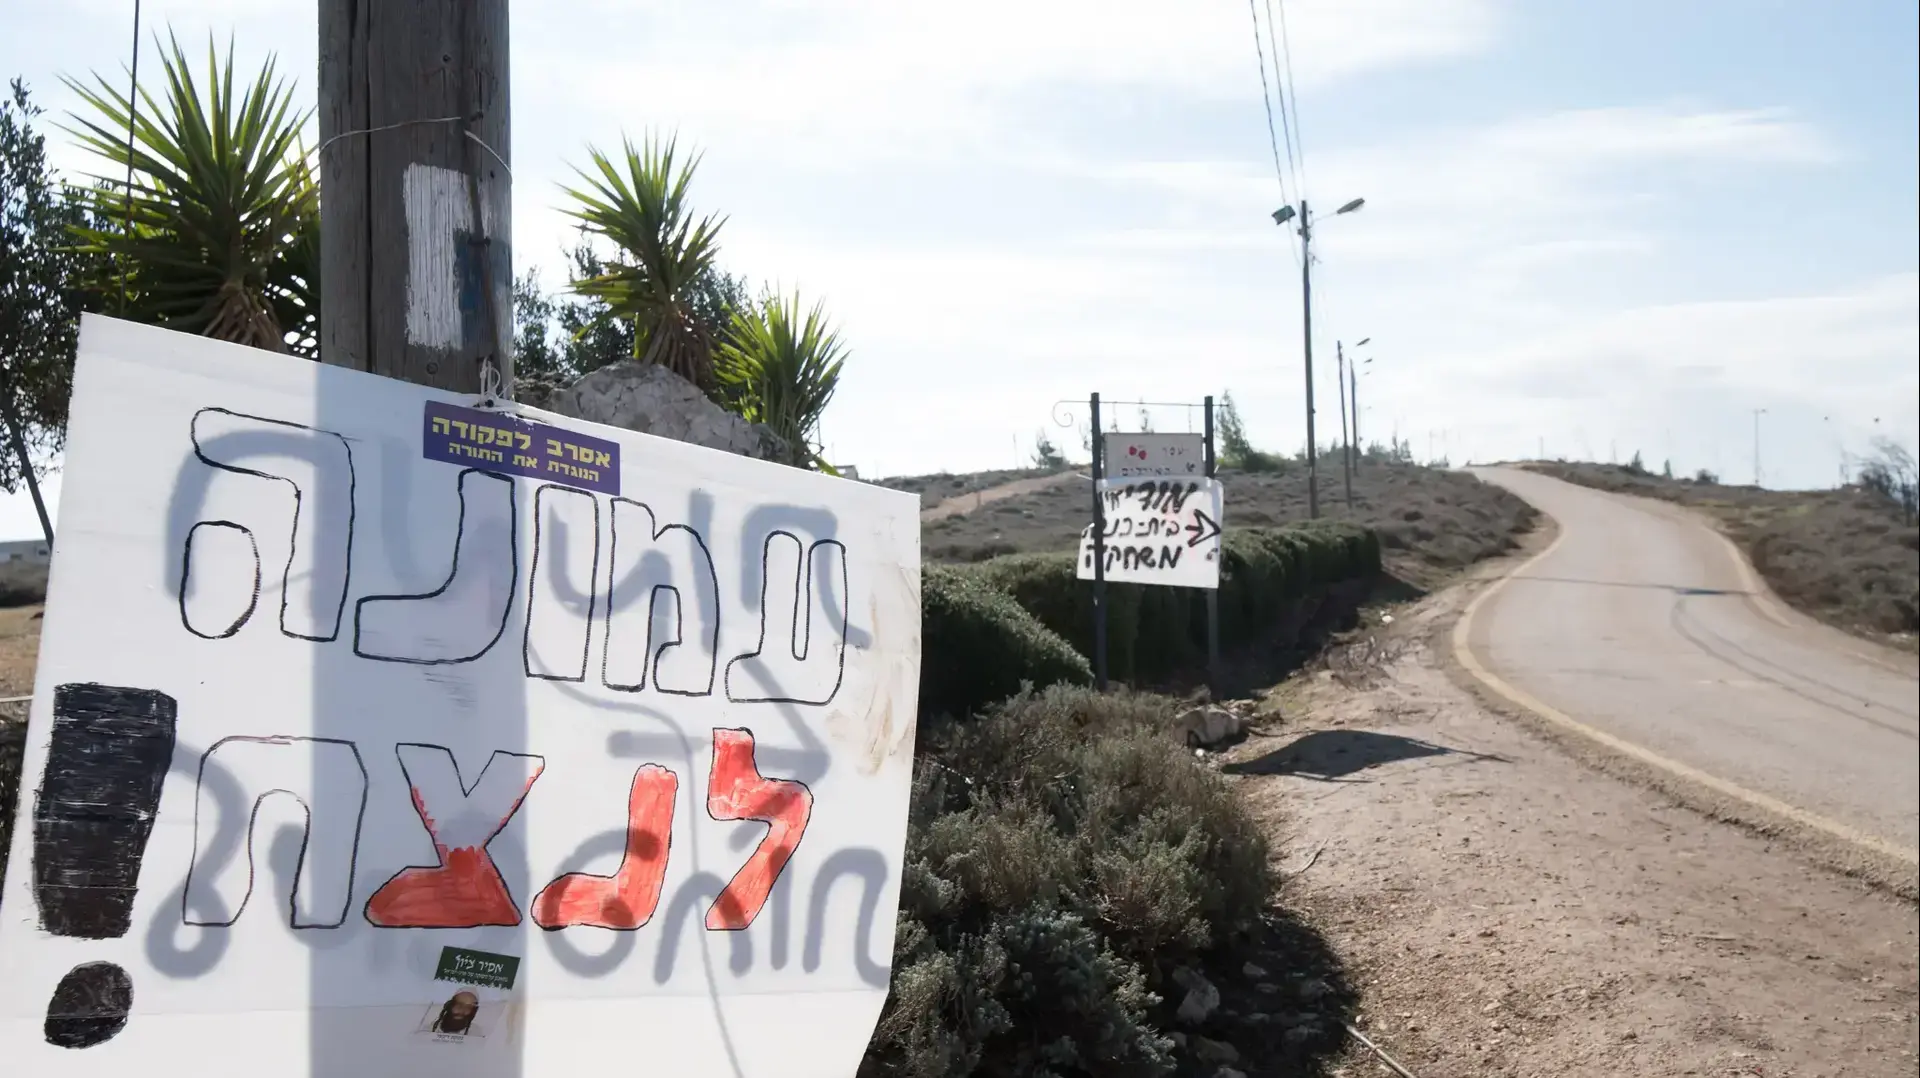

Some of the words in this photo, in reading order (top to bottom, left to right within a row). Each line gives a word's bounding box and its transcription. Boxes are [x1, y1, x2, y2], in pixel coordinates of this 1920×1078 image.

[432, 416, 532, 450] לפקודה
[448, 442, 504, 463] התורה
[512, 454, 538, 469] את
[546, 438, 611, 469] אסרב
[547, 460, 600, 483] הנוגדת
[178, 406, 848, 706] עמונה
